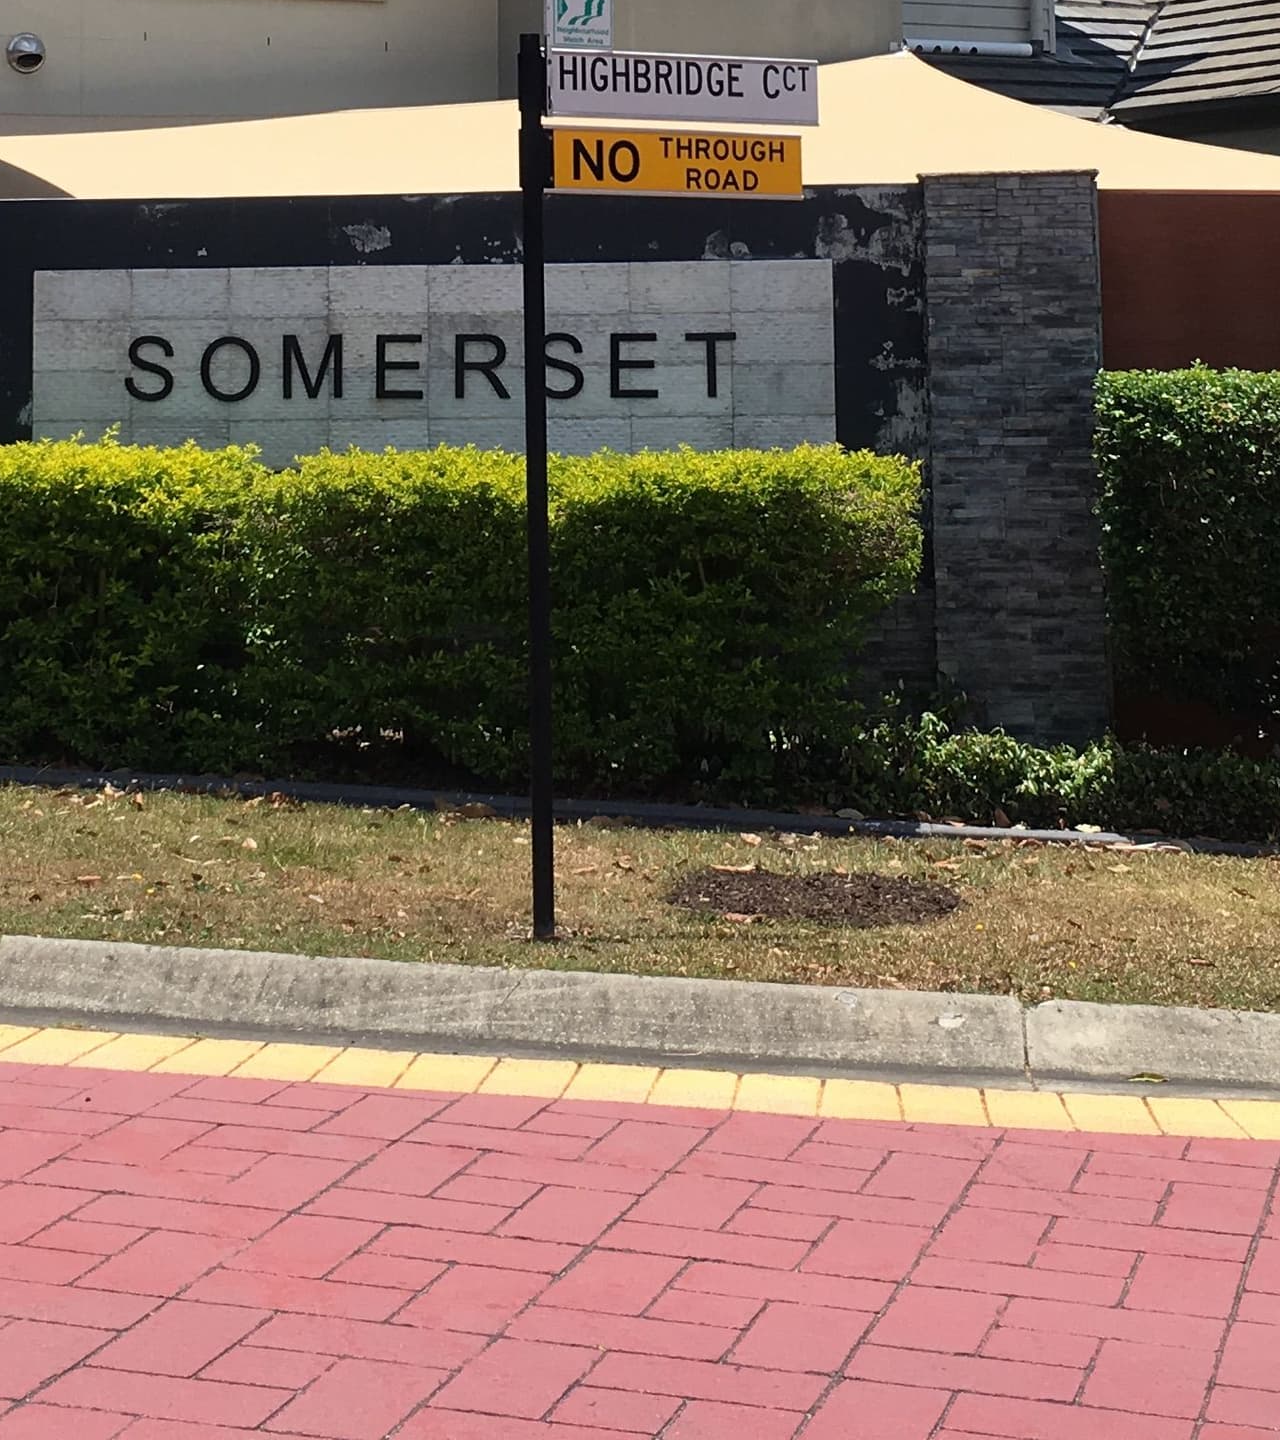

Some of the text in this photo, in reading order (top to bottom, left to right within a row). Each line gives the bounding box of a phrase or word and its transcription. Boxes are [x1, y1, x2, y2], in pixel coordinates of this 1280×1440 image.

[558, 55, 810, 99] HIGHBRIDGE CCT
[572, 136, 785, 183] NO THROUGH
[686, 168, 759, 192] ROAD
[124, 330, 737, 402] SOMERSET
